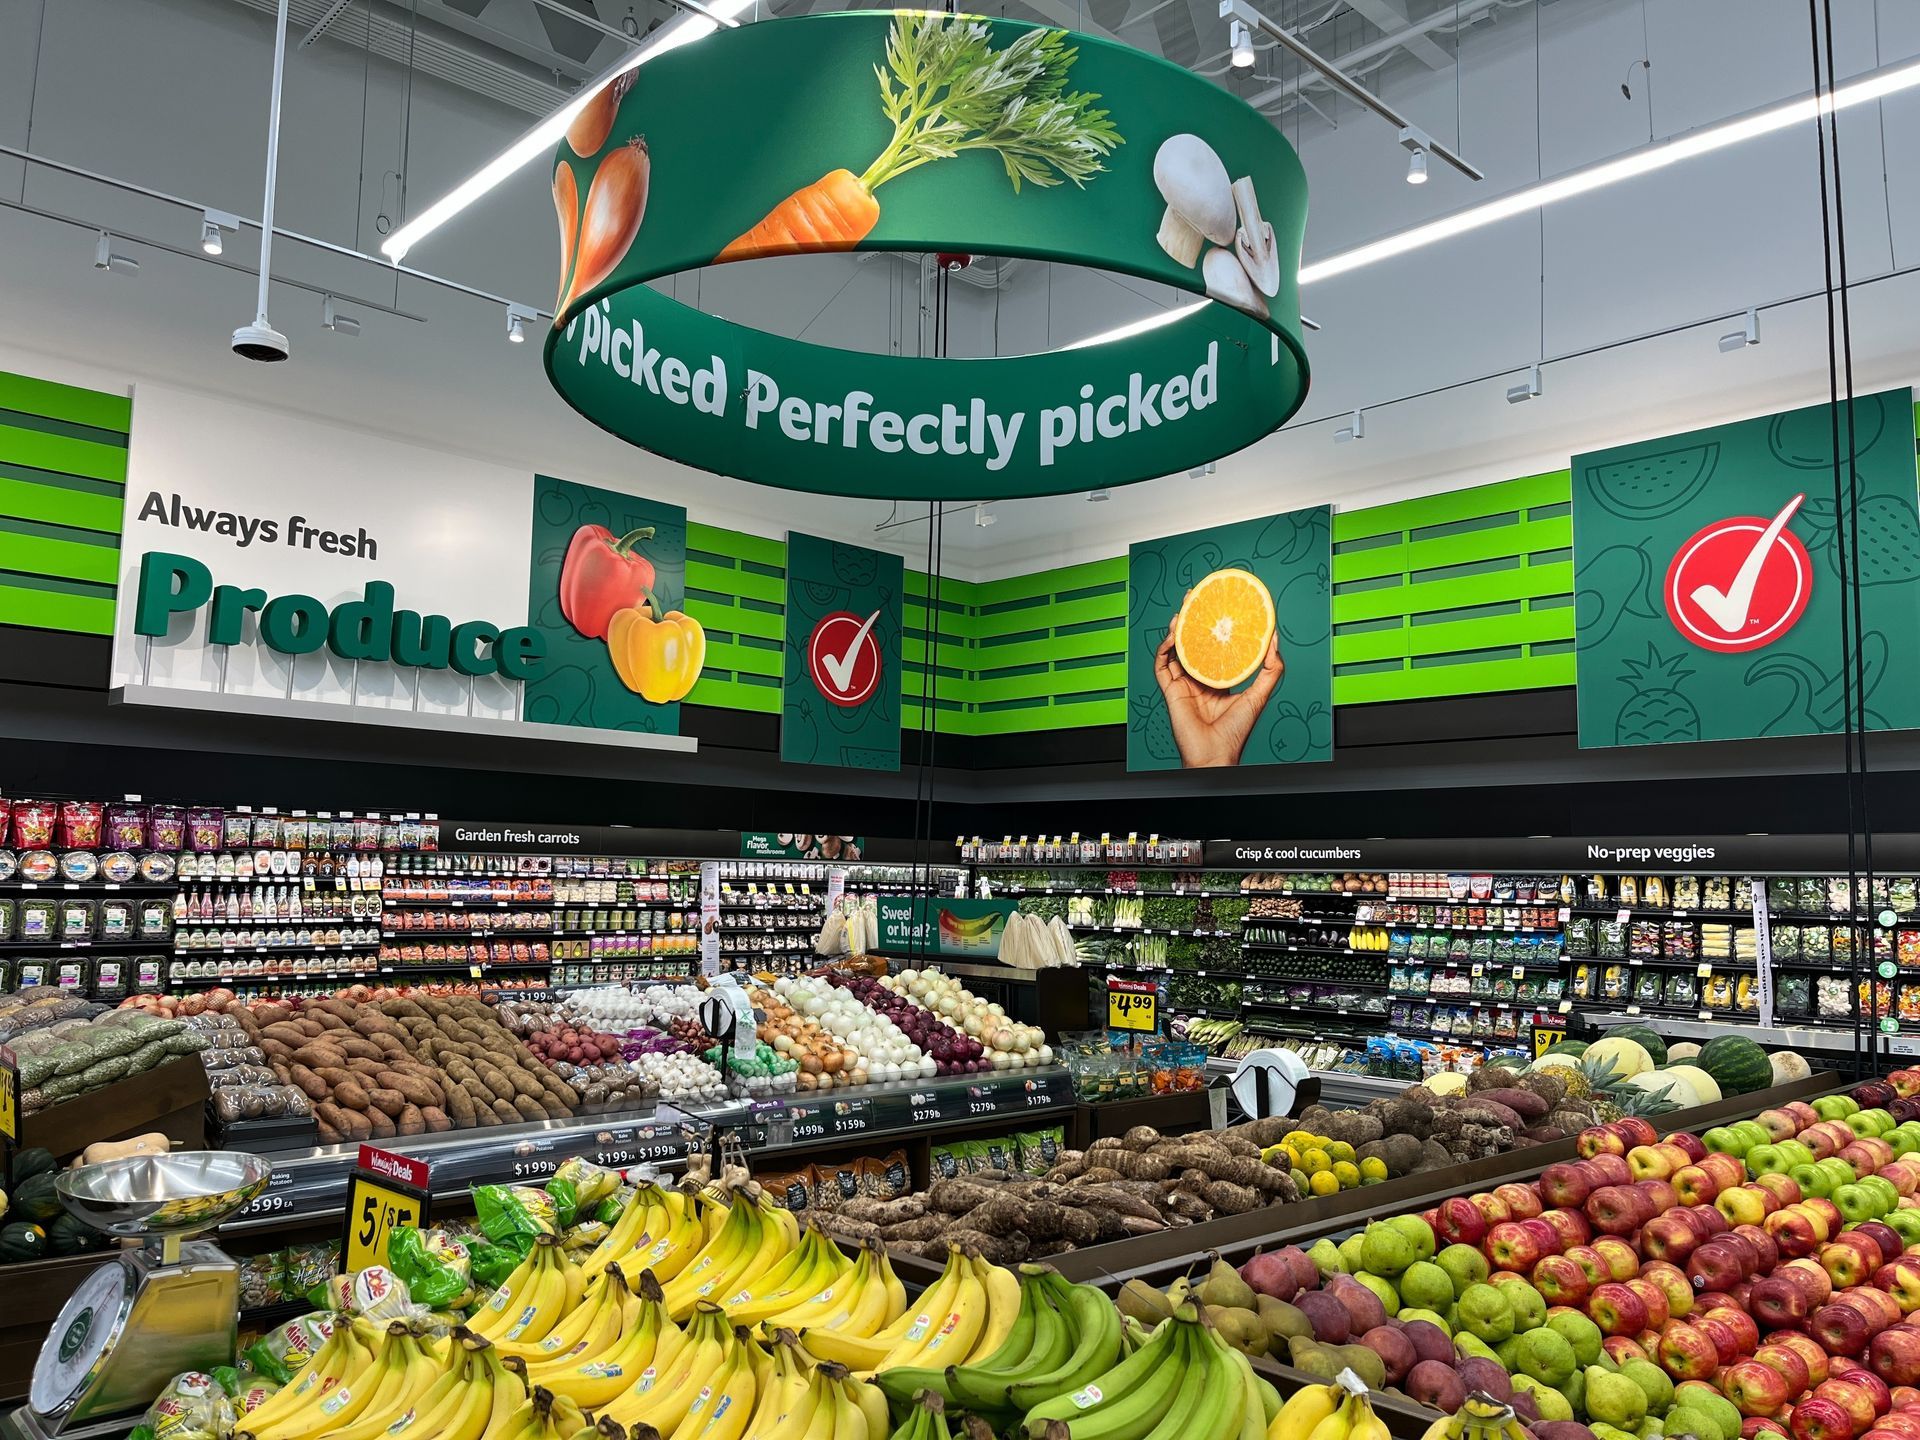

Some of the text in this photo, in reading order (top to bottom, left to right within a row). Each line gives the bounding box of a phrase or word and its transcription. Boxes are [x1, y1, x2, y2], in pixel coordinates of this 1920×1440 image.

[578, 297, 1218, 471] picked Perfectly picked
[138, 491, 378, 561] Always fresh
[134, 551, 547, 681] Produce
[455, 828, 580, 844] Garden fresh carrots
[746, 840, 769, 850] flavor
[752, 835, 767, 843] Mega
[1235, 846, 1361, 862] Crisp & cool cucumbers
[1587, 844, 1716, 862] No-prep veggies
[887, 924, 898, 936] or
[1758, 910, 1766, 942] Fresh
[756, 1101, 773, 1109] Organic
[392, 1160, 413, 1182] Deals
[269, 1178, 293, 1186] Potatoes
[367, 1268, 389, 1298] Dole
[286, 1323, 310, 1353] Minis
